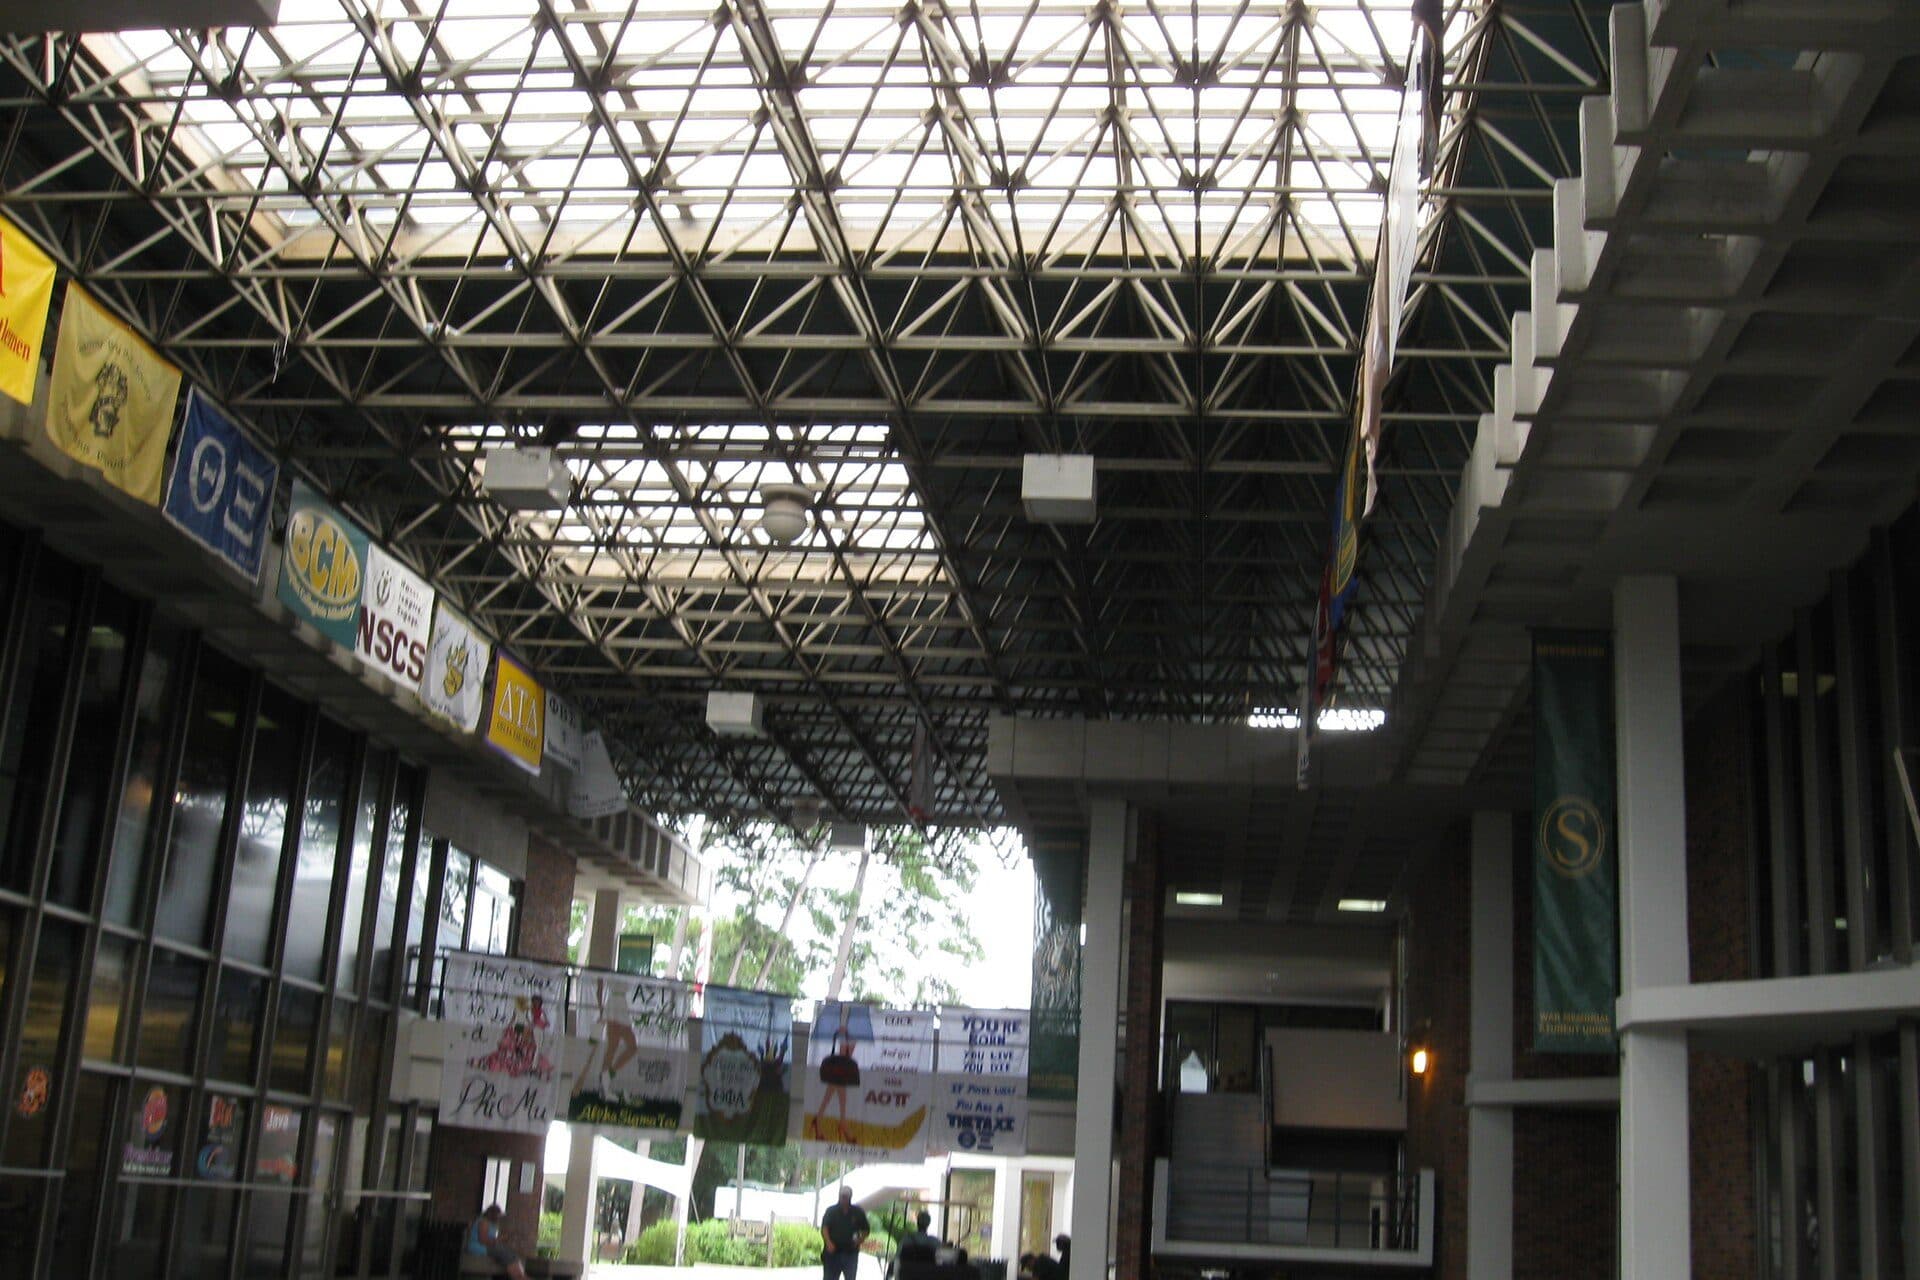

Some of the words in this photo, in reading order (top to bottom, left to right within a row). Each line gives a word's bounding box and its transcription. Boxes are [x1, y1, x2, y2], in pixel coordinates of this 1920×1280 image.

[292, 514, 358, 600] BCM
[356, 605, 426, 683] NSCS
[1555, 812, 1588, 866] S
[1539, 1011, 1561, 1023] WAR
[968, 1033, 1006, 1047] BORN
[964, 1050, 984, 1061] YOU
[963, 1062, 983, 1075] YOU
